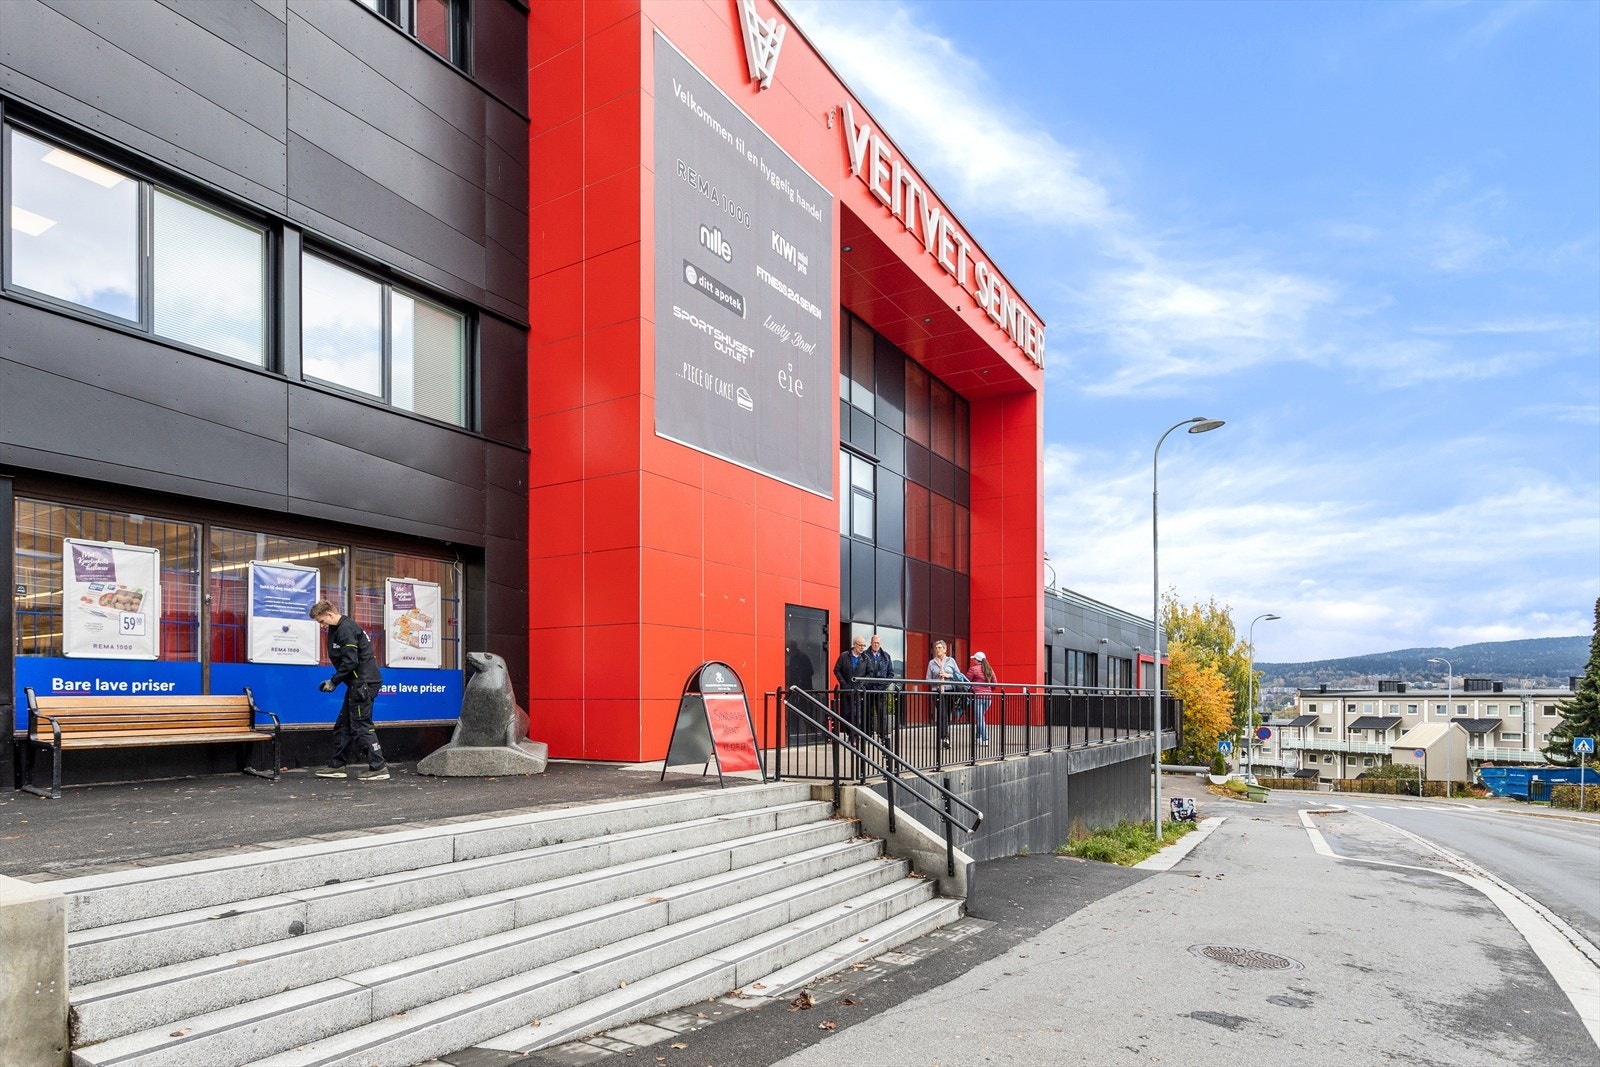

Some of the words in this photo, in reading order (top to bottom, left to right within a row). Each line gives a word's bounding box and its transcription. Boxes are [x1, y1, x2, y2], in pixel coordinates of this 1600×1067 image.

[672, 77, 734, 146] Velkommen
[736, 137, 745, 156] til
[747, 151, 758, 167] en
[760, 157, 795, 203] hyggelig
[677, 158, 720, 206] REMA
[722, 194, 751, 229] 1000
[700, 225, 732, 262] nille
[771, 229, 797, 267] KIWI
[842, 101, 971, 286] VEITVET
[974, 261, 1045, 370] SENTER
[698, 275, 714, 293] ditt
[714, 288, 742, 311] apotek
[673, 305, 755, 358] SPORTSHUSET
[763, 314, 791, 343] Lucky
[791, 332, 817, 355] Bowl
[714, 340, 747, 364] OUTLET
[704, 372, 713, 391] OF
[778, 362, 803, 398] eie
[52, 677, 91, 691] Bare
[95, 678, 128, 691] lave
[132, 679, 175, 694] priser
[378, 684, 397, 693] are
[399, 682, 418, 693] lave
[420, 682, 446, 695] priser
